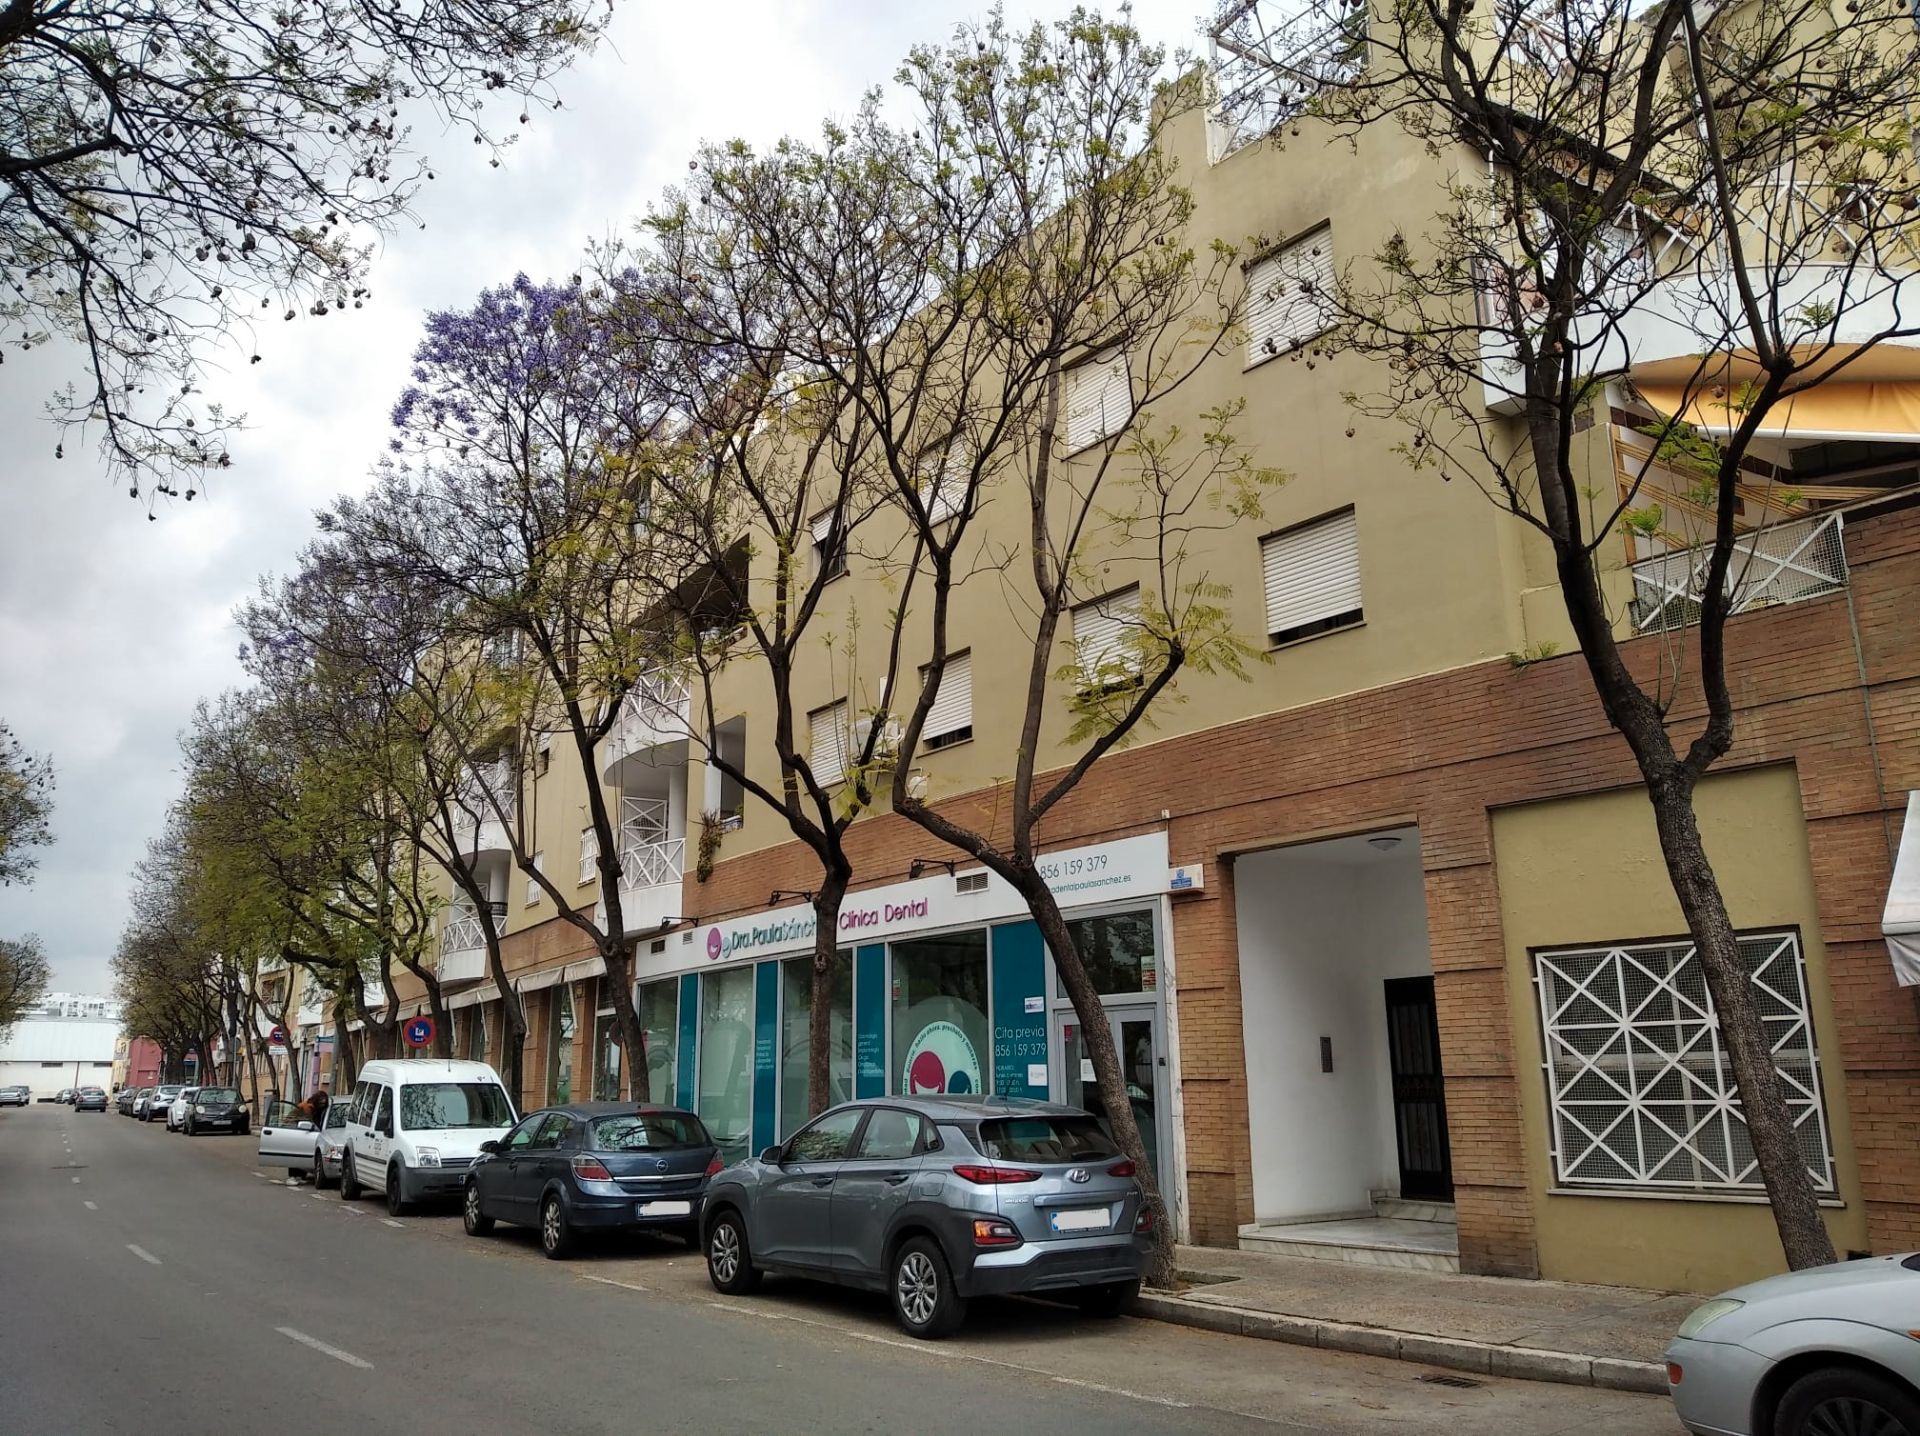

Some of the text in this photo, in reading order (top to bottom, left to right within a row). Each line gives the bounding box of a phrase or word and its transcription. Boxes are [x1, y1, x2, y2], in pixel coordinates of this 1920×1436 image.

[1040, 854, 1108, 880] 856 159 379
[1050, 874, 1132, 894] adentalpaulasanchez.es
[839, 908, 879, 930] Clínica
[884, 896, 929, 923] Dental
[995, 1024, 1045, 1041] Cita previa
[995, 1042, 1047, 1057] 856 159 379
